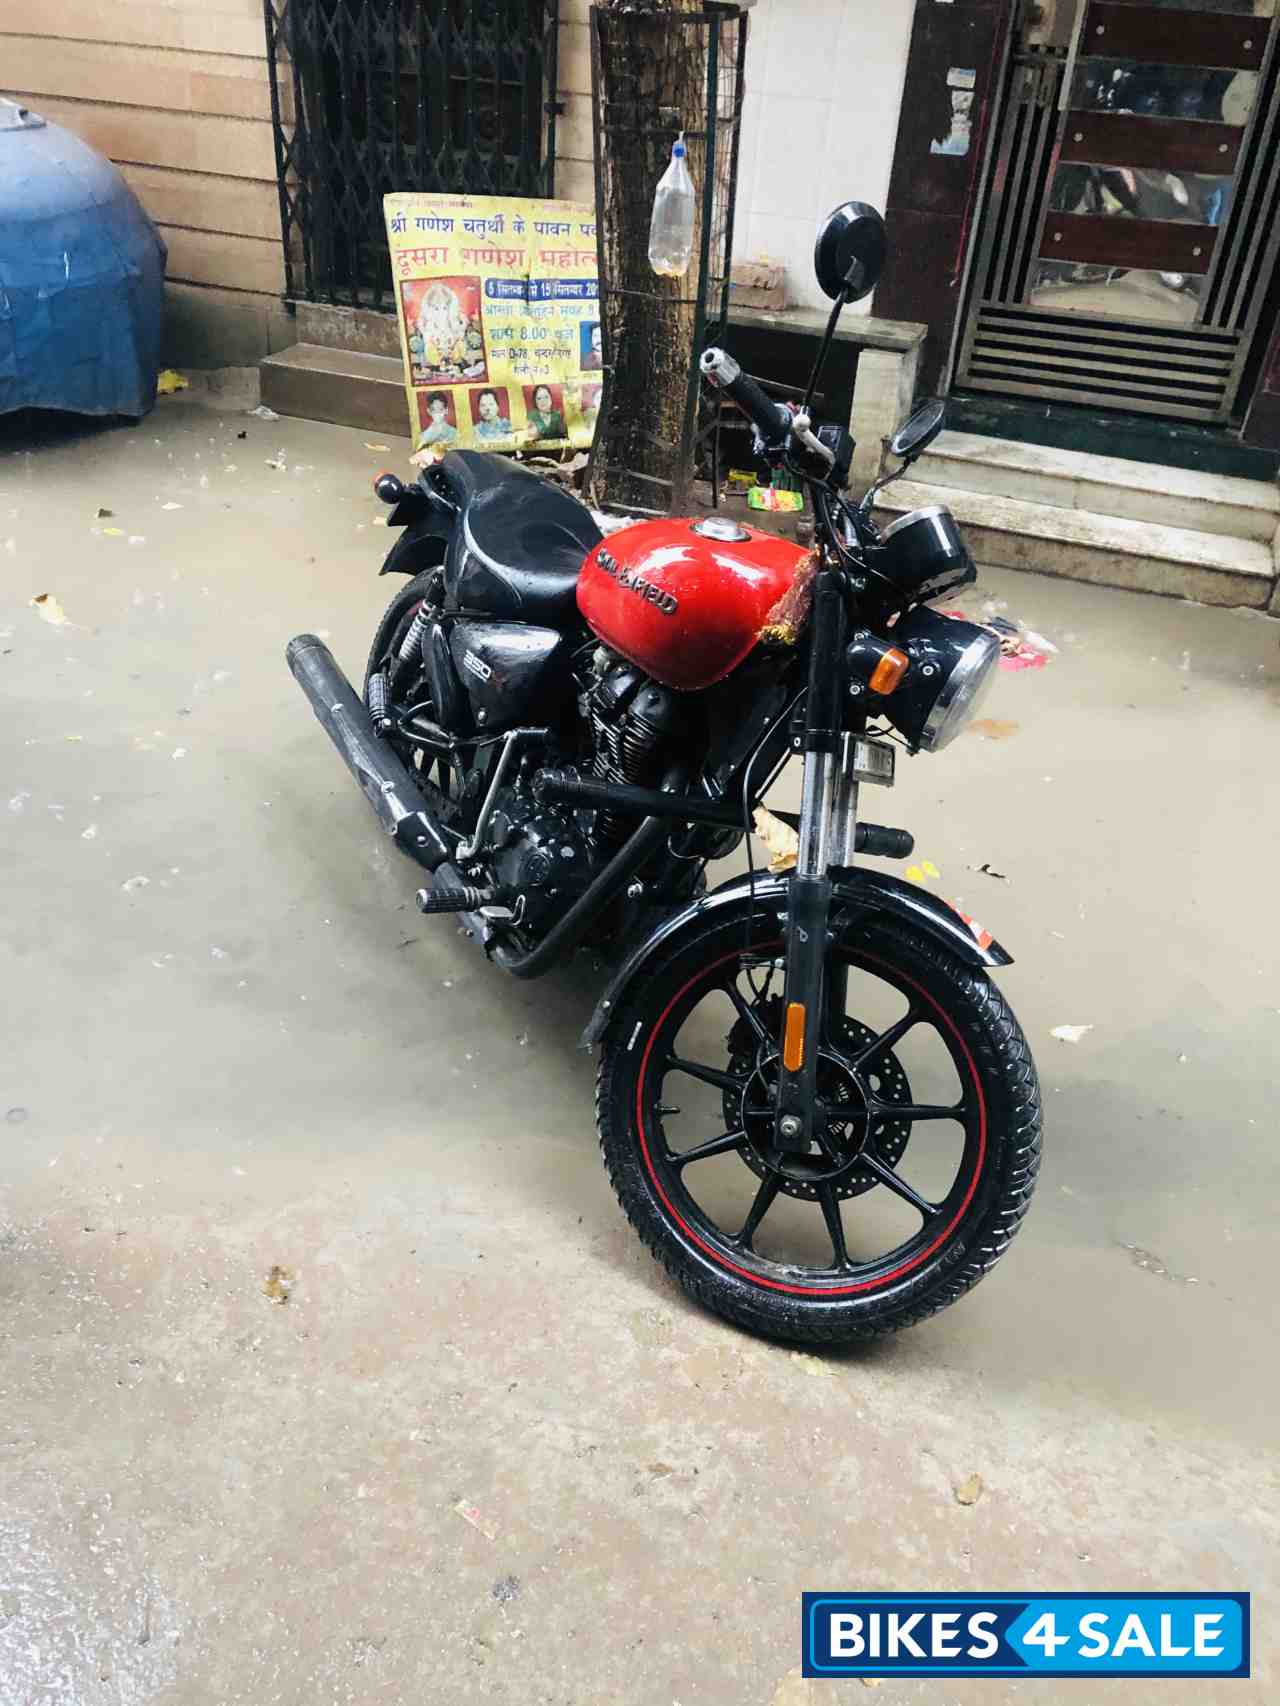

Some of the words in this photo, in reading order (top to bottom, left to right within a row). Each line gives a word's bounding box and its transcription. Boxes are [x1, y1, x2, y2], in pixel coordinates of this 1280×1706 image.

[391, 211, 406, 232] श्री
[415, 210, 454, 232] गणेश
[463, 213, 504, 240] चतुर्थी
[512, 214, 525, 234] के
[532, 222, 571, 236] पावन
[396, 247, 448, 276] दूसरा
[462, 240, 526, 268] गणेश
[520, 326, 547, 341] 8.00
[463, 649, 492, 679] 350
